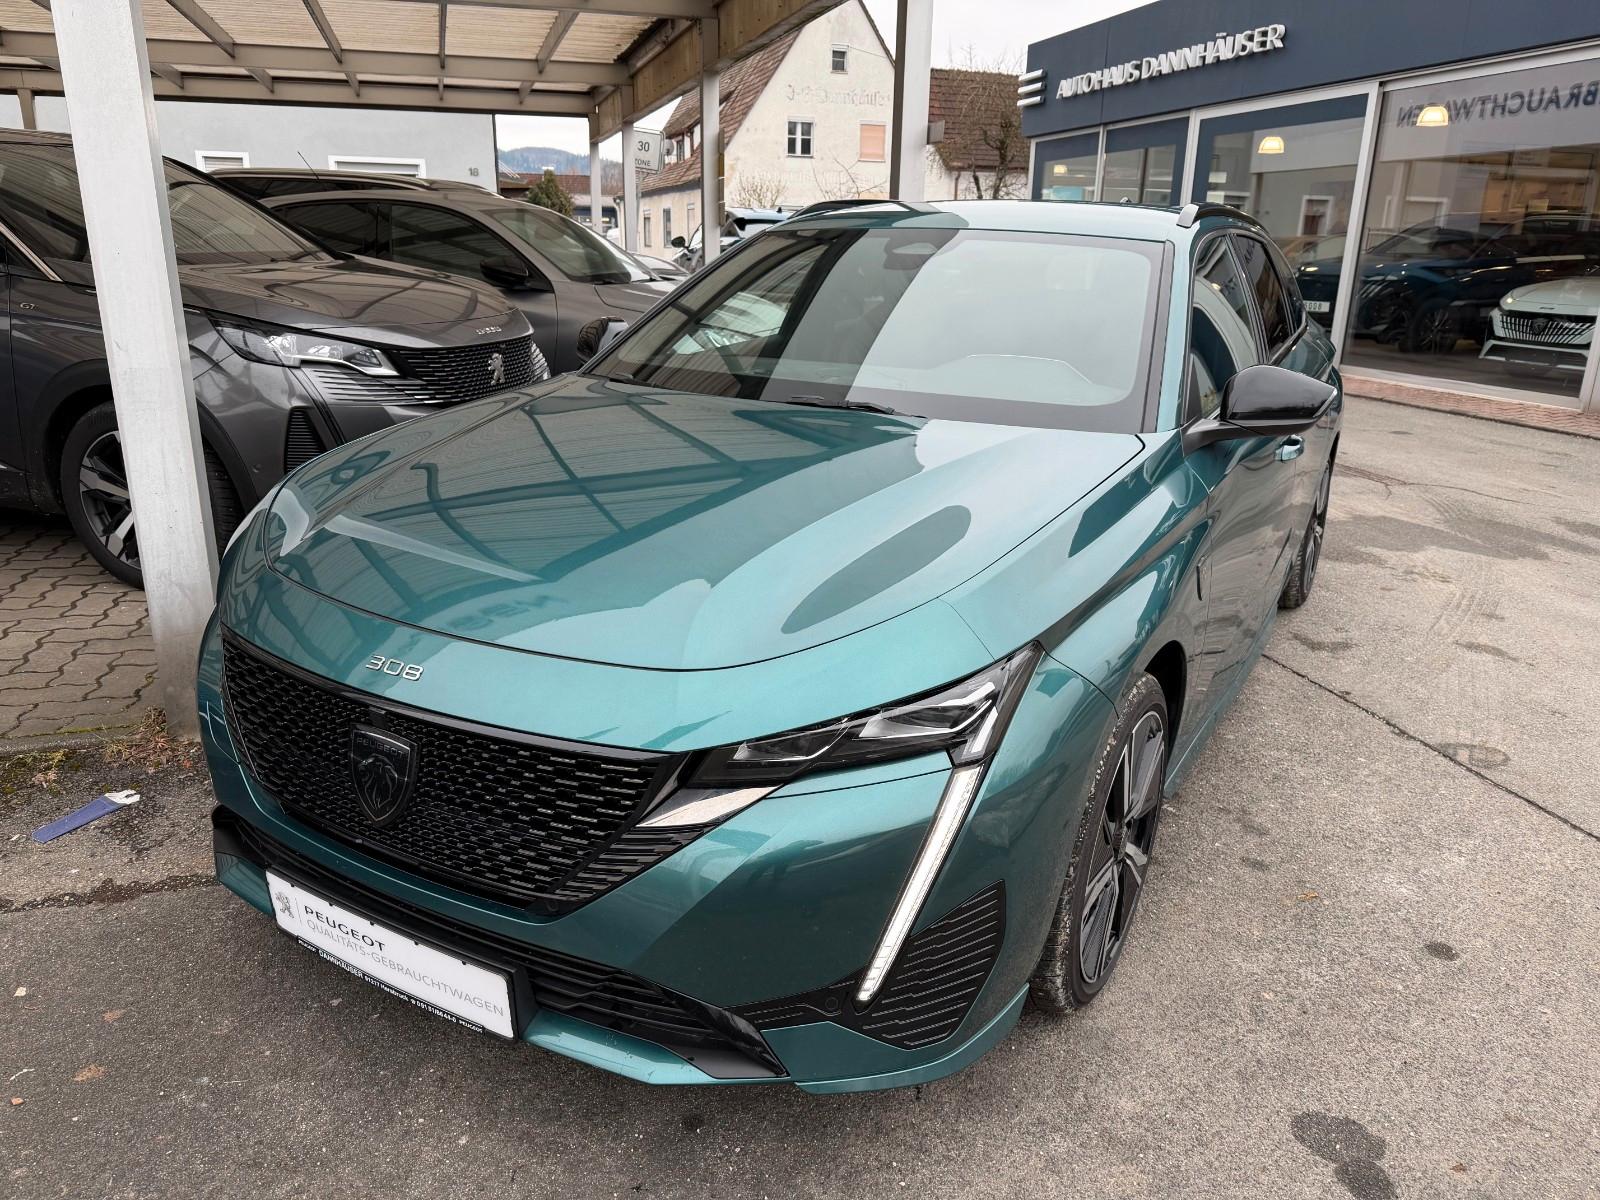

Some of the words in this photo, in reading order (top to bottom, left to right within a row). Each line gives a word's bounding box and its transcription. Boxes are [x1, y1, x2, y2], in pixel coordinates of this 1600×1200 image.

[1056, 60, 1142, 99] AUTOHAUS
[1140, 24, 1286, 80] DANNHÄUSER
[637, 140, 650, 152] 30
[468, 167, 479, 176] 18
[365, 655, 424, 681] 308
[356, 737, 404, 759] PEUGEOT
[304, 904, 386, 951] PEUGEOT
[306, 919, 504, 1017] QUALITÄTS-GEBRAUCHTWAGEN
